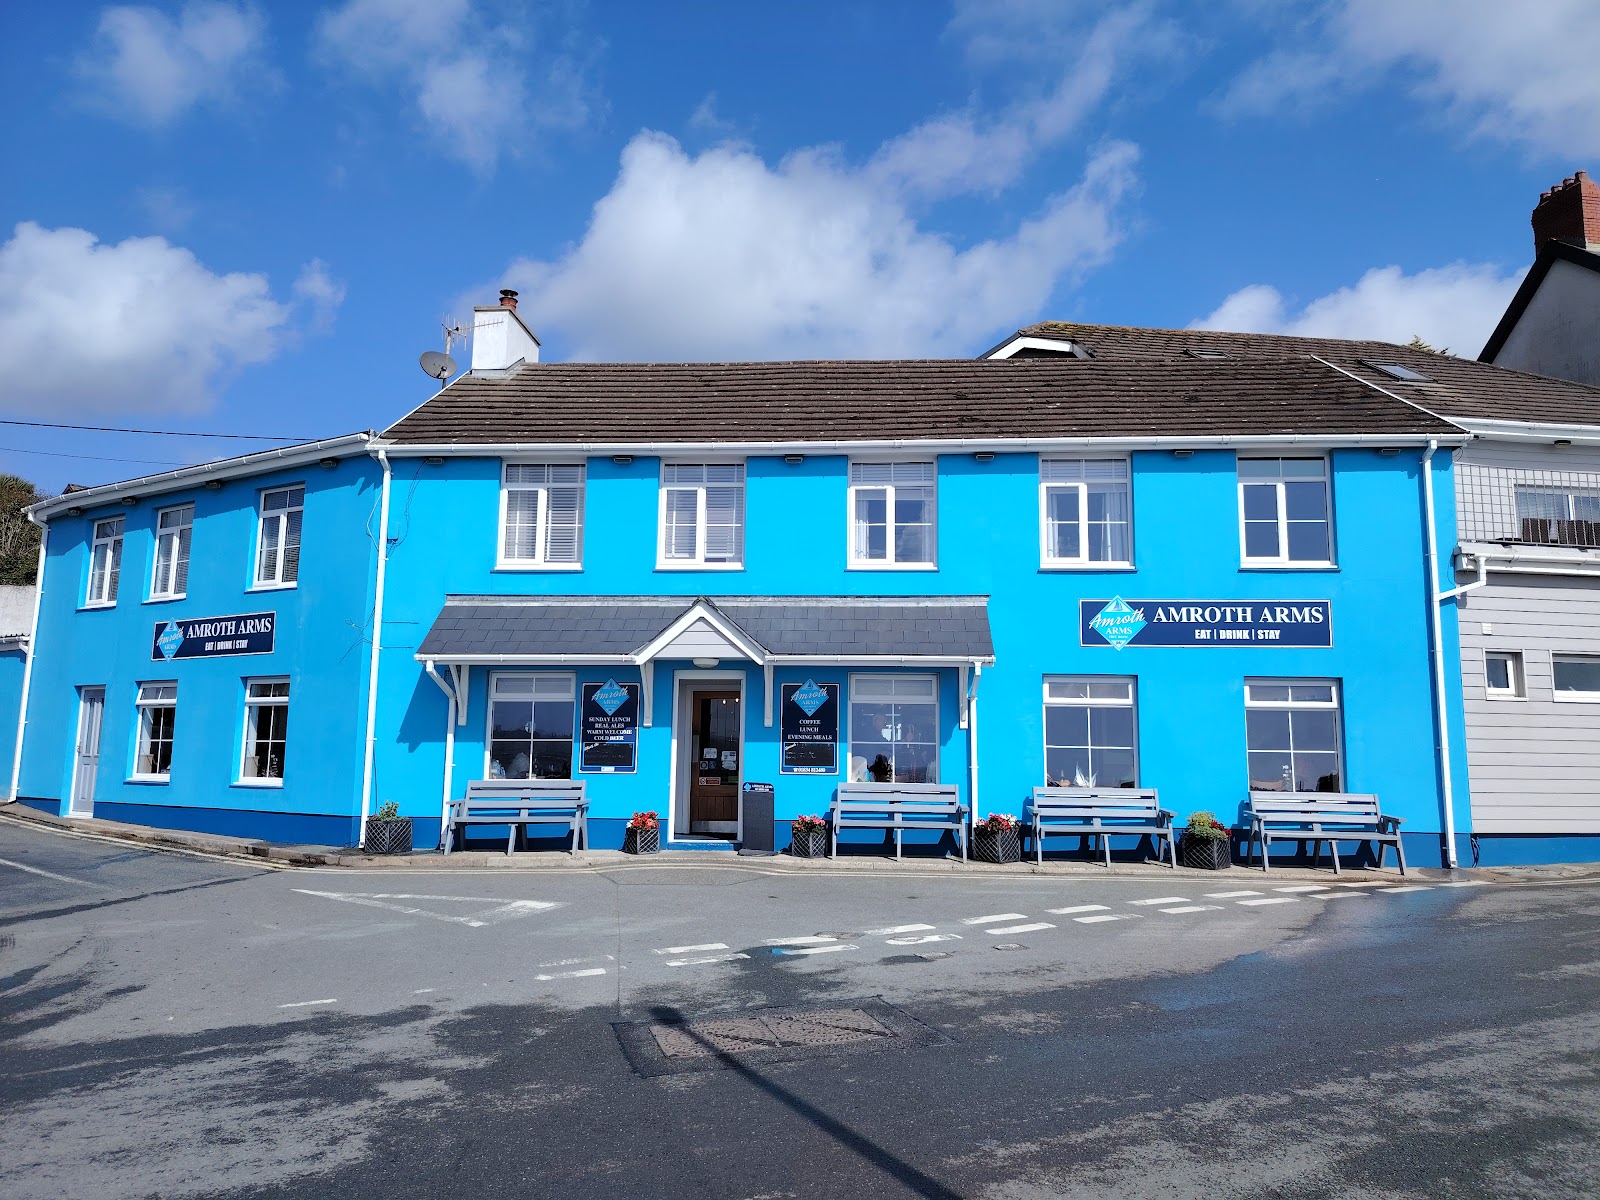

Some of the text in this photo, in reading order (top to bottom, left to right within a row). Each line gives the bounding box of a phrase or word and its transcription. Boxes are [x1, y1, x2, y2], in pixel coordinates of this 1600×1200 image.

[1088, 607, 1146, 629] Amroth
[1152, 606, 1324, 624] AMROTH ARMS
[186, 617, 272, 639] AMROTH ARMS
[1105, 627, 1132, 635] ARMS
[1195, 629, 1211, 639] EAT
[1219, 629, 1249, 639] DRINK
[1257, 629, 1280, 639] STAY
[205, 641, 215, 651] EAT
[217, 641, 233, 650] DRINK
[235, 639, 248, 649] STAY
[591, 686, 629, 701] Amroth
[790, 687, 828, 702] Amroth
